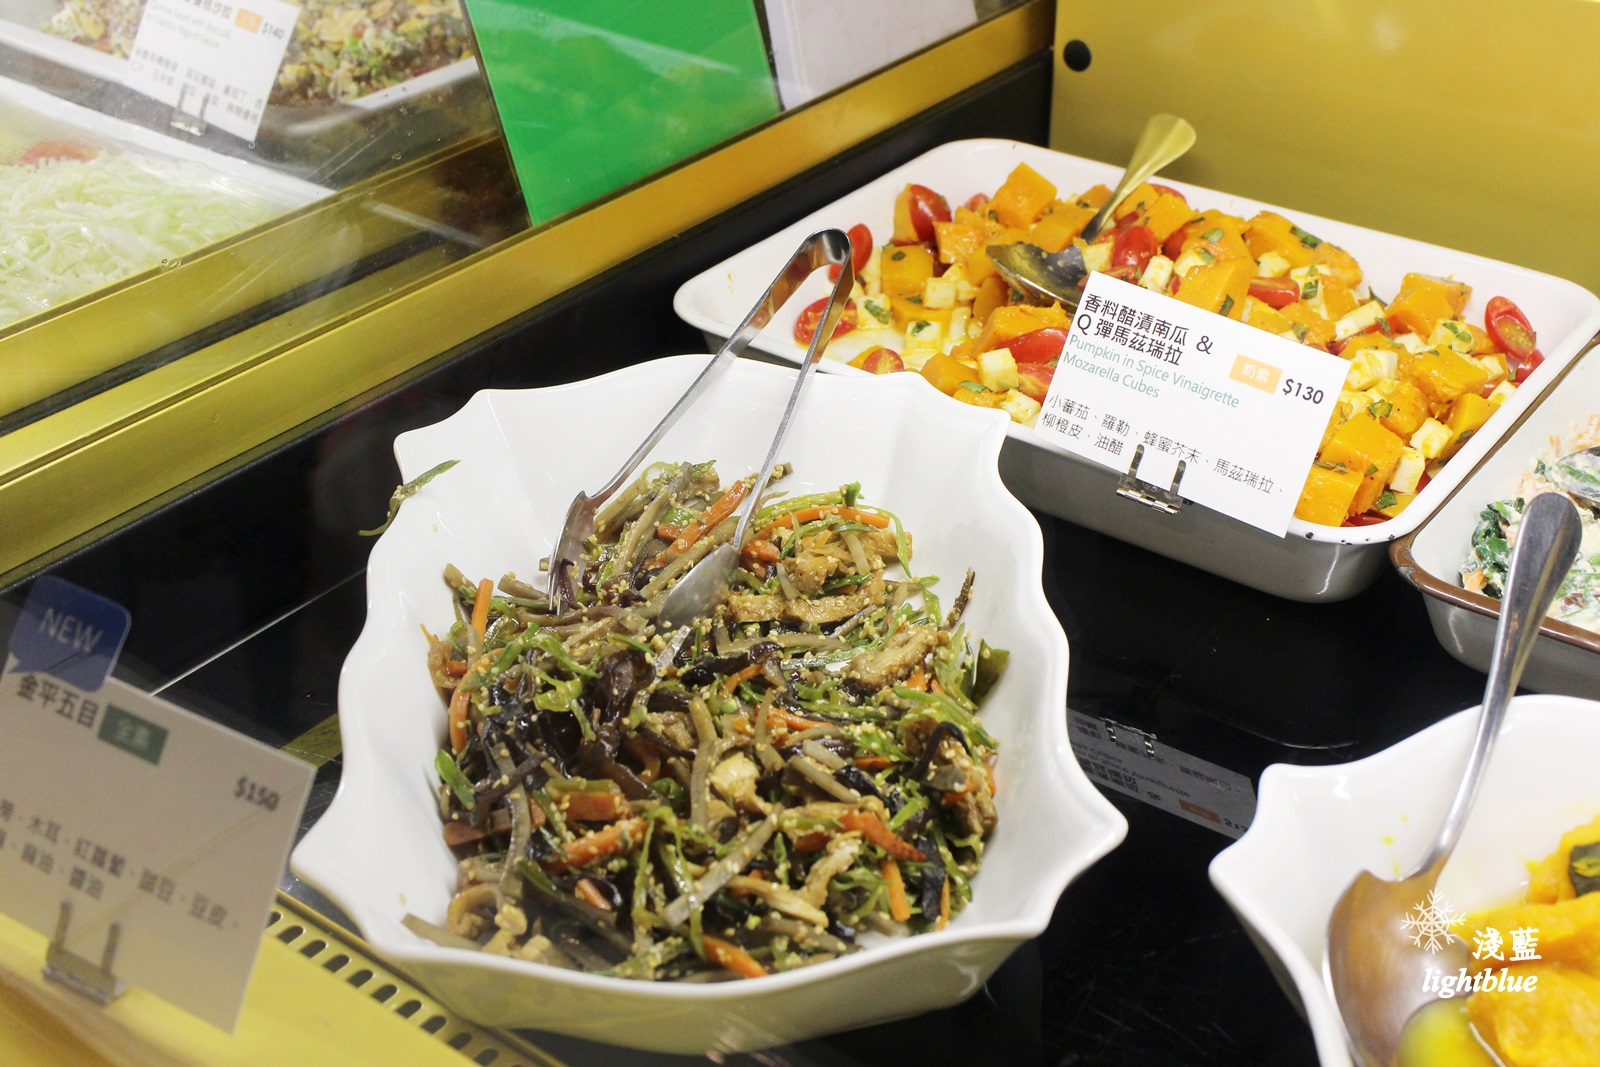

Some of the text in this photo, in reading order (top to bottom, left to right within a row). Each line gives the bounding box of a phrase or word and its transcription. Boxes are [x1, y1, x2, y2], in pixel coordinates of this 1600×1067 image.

[261, 22, 286, 41] $140
[1084, 293, 1213, 355] 香料醋漬南瓜 &
[1062, 350, 1161, 399] Mozarella Cubes
[1068, 333, 1241, 409] Pumpkin in Spice Vinaigrette
[1282, 377, 1325, 407] $130
[38, 607, 104, 655] NEW
[16, 672, 99, 730] 金平五目
[233, 775, 281, 812] $150
